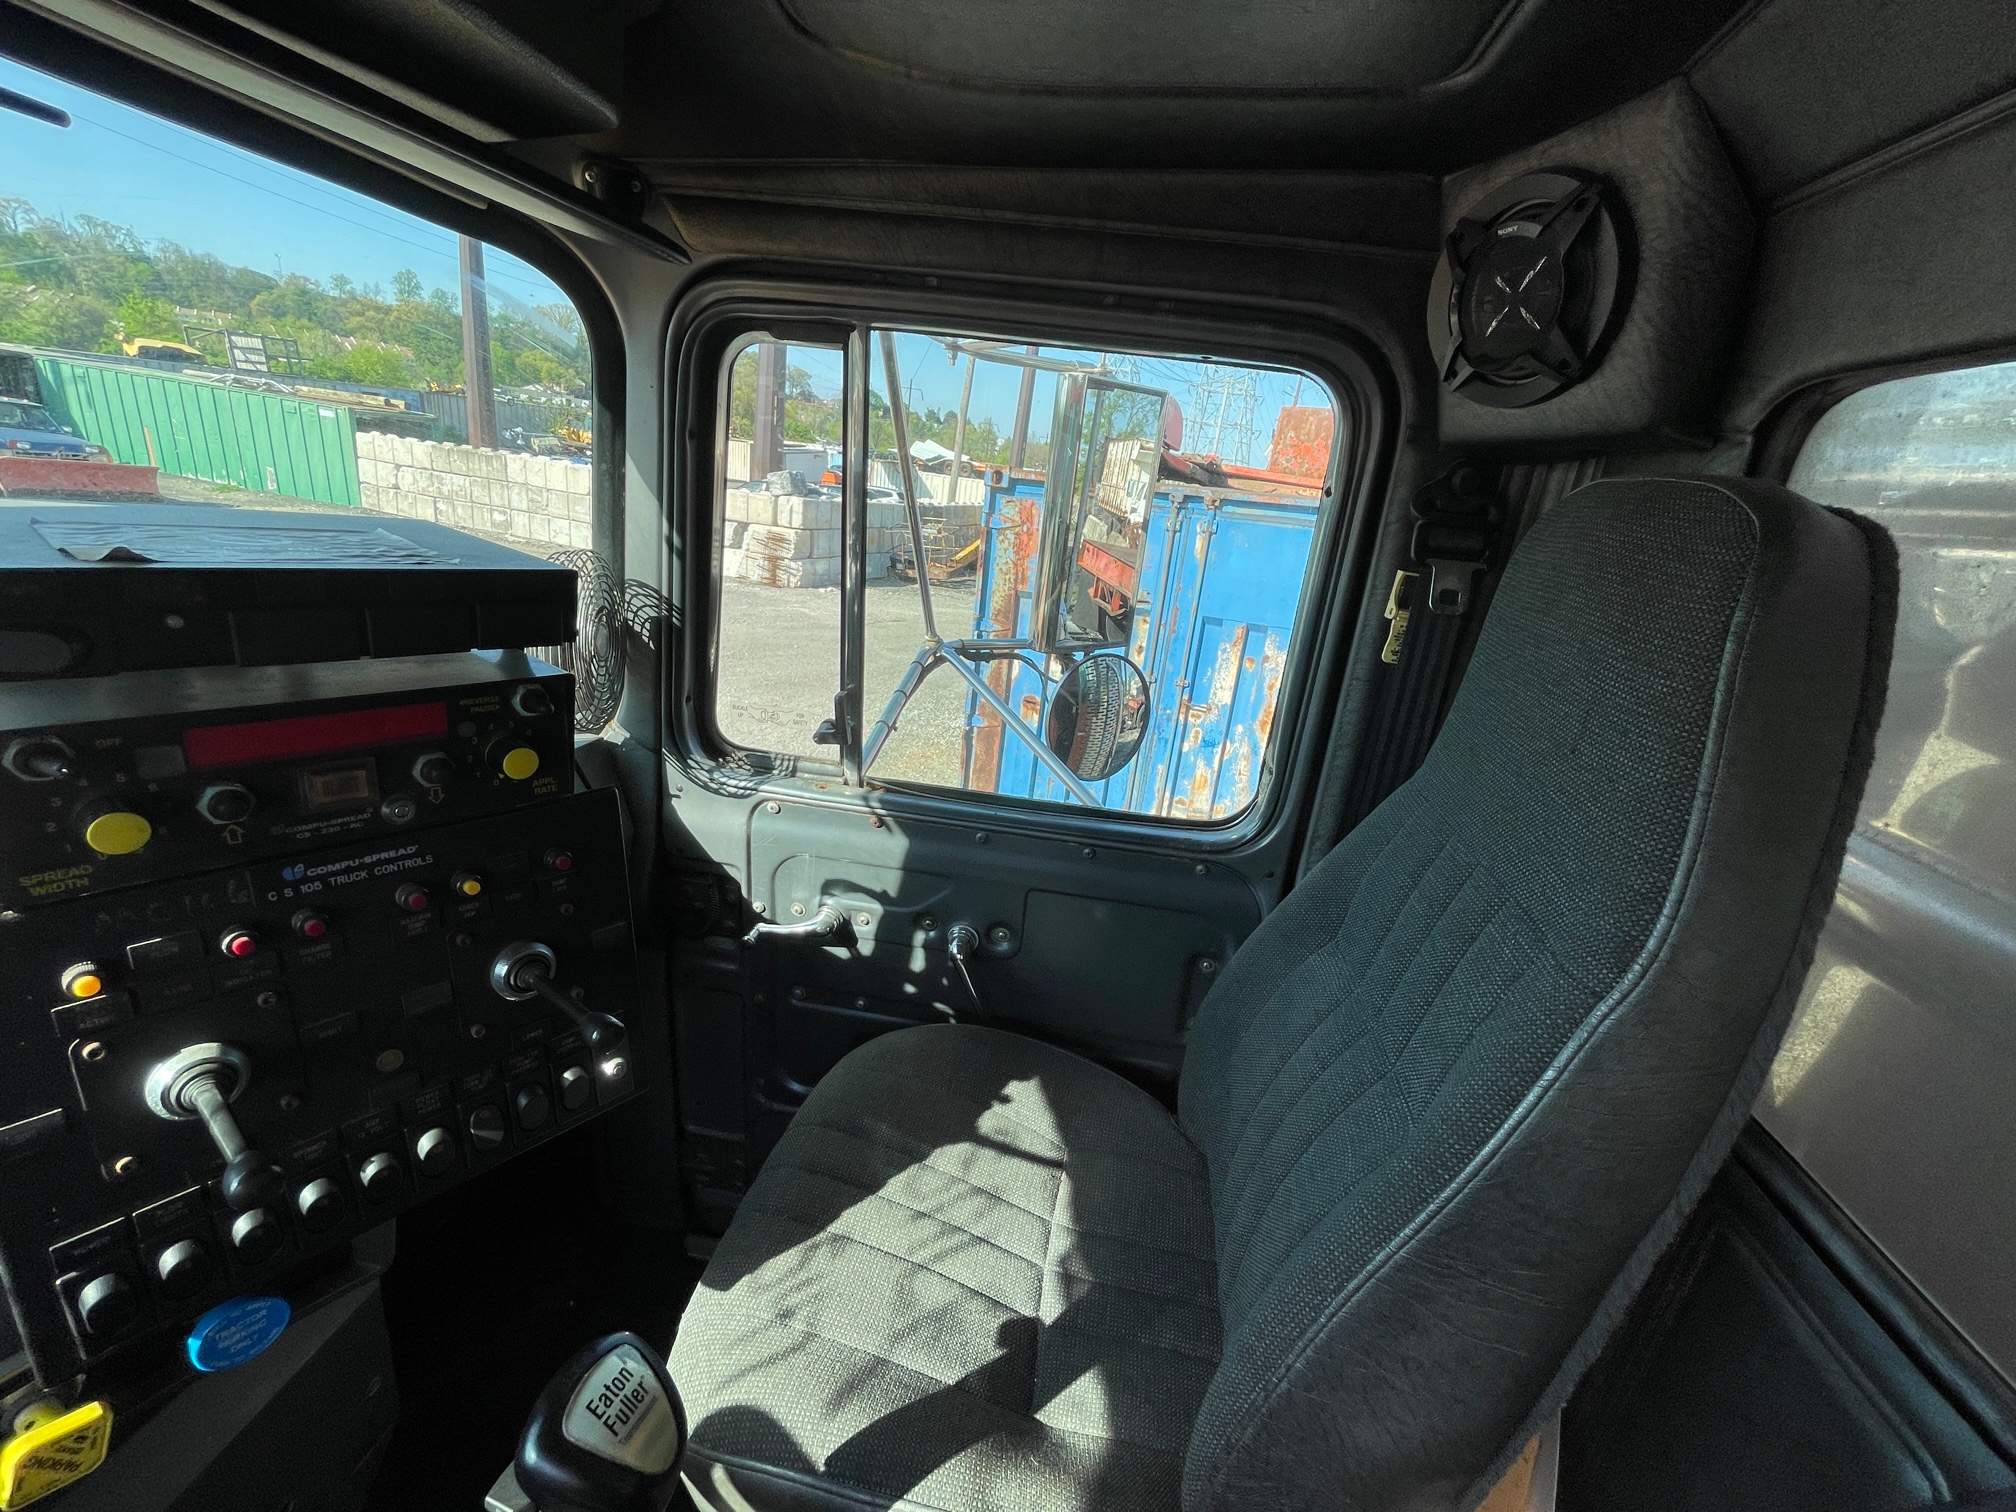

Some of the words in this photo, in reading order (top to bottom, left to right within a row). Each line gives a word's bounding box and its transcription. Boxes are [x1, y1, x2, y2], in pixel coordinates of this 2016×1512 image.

[1497, 224, 1518, 236] SONY
[464, 696, 500, 705] REVERSE
[534, 784, 559, 796] RATE
[46, 822, 58, 832] 2
[306, 847, 417, 877] COMPU-SPREAD
[19, 864, 94, 887] SPREAD
[29, 877, 90, 897] WIDTH
[267, 891, 278, 902] C
[283, 887, 294, 898] S
[300, 882, 323, 895] 105
[328, 869, 369, 888] TRUCK
[374, 853, 434, 876] CONTROLS
[215, 1309, 268, 1341] TRACTOR
[585, 1366, 634, 1421] Eaton
[602, 1380, 649, 1437] Fuller
